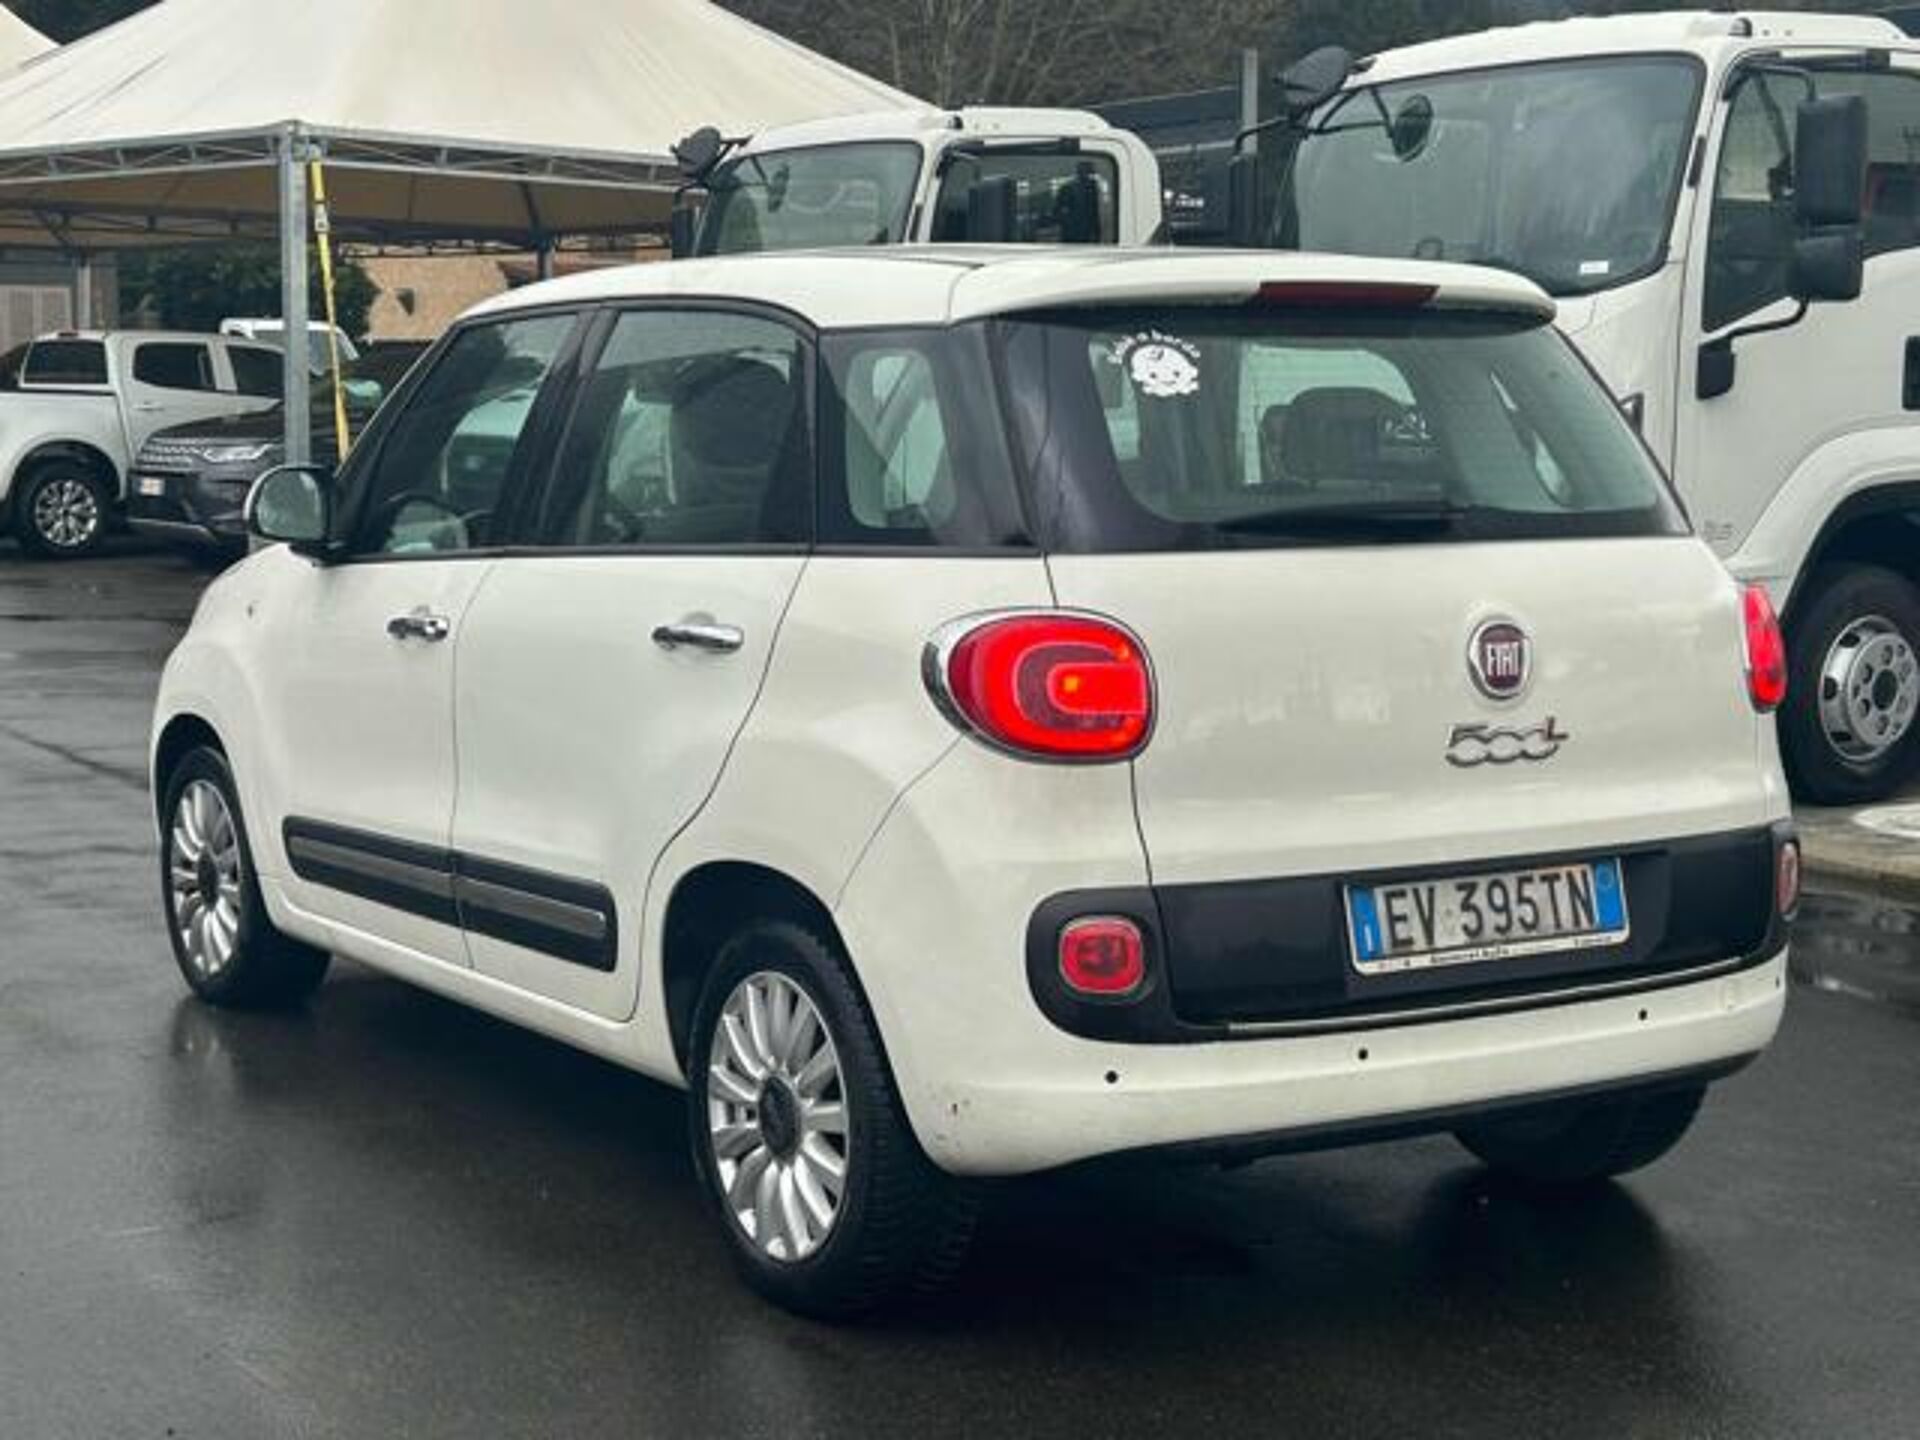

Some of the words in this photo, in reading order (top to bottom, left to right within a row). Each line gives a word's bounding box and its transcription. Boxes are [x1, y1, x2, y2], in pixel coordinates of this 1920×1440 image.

[1486, 641, 1520, 677] FIAT
[1383, 885, 1437, 949] EV
[1455, 868, 1597, 938] 395TN
